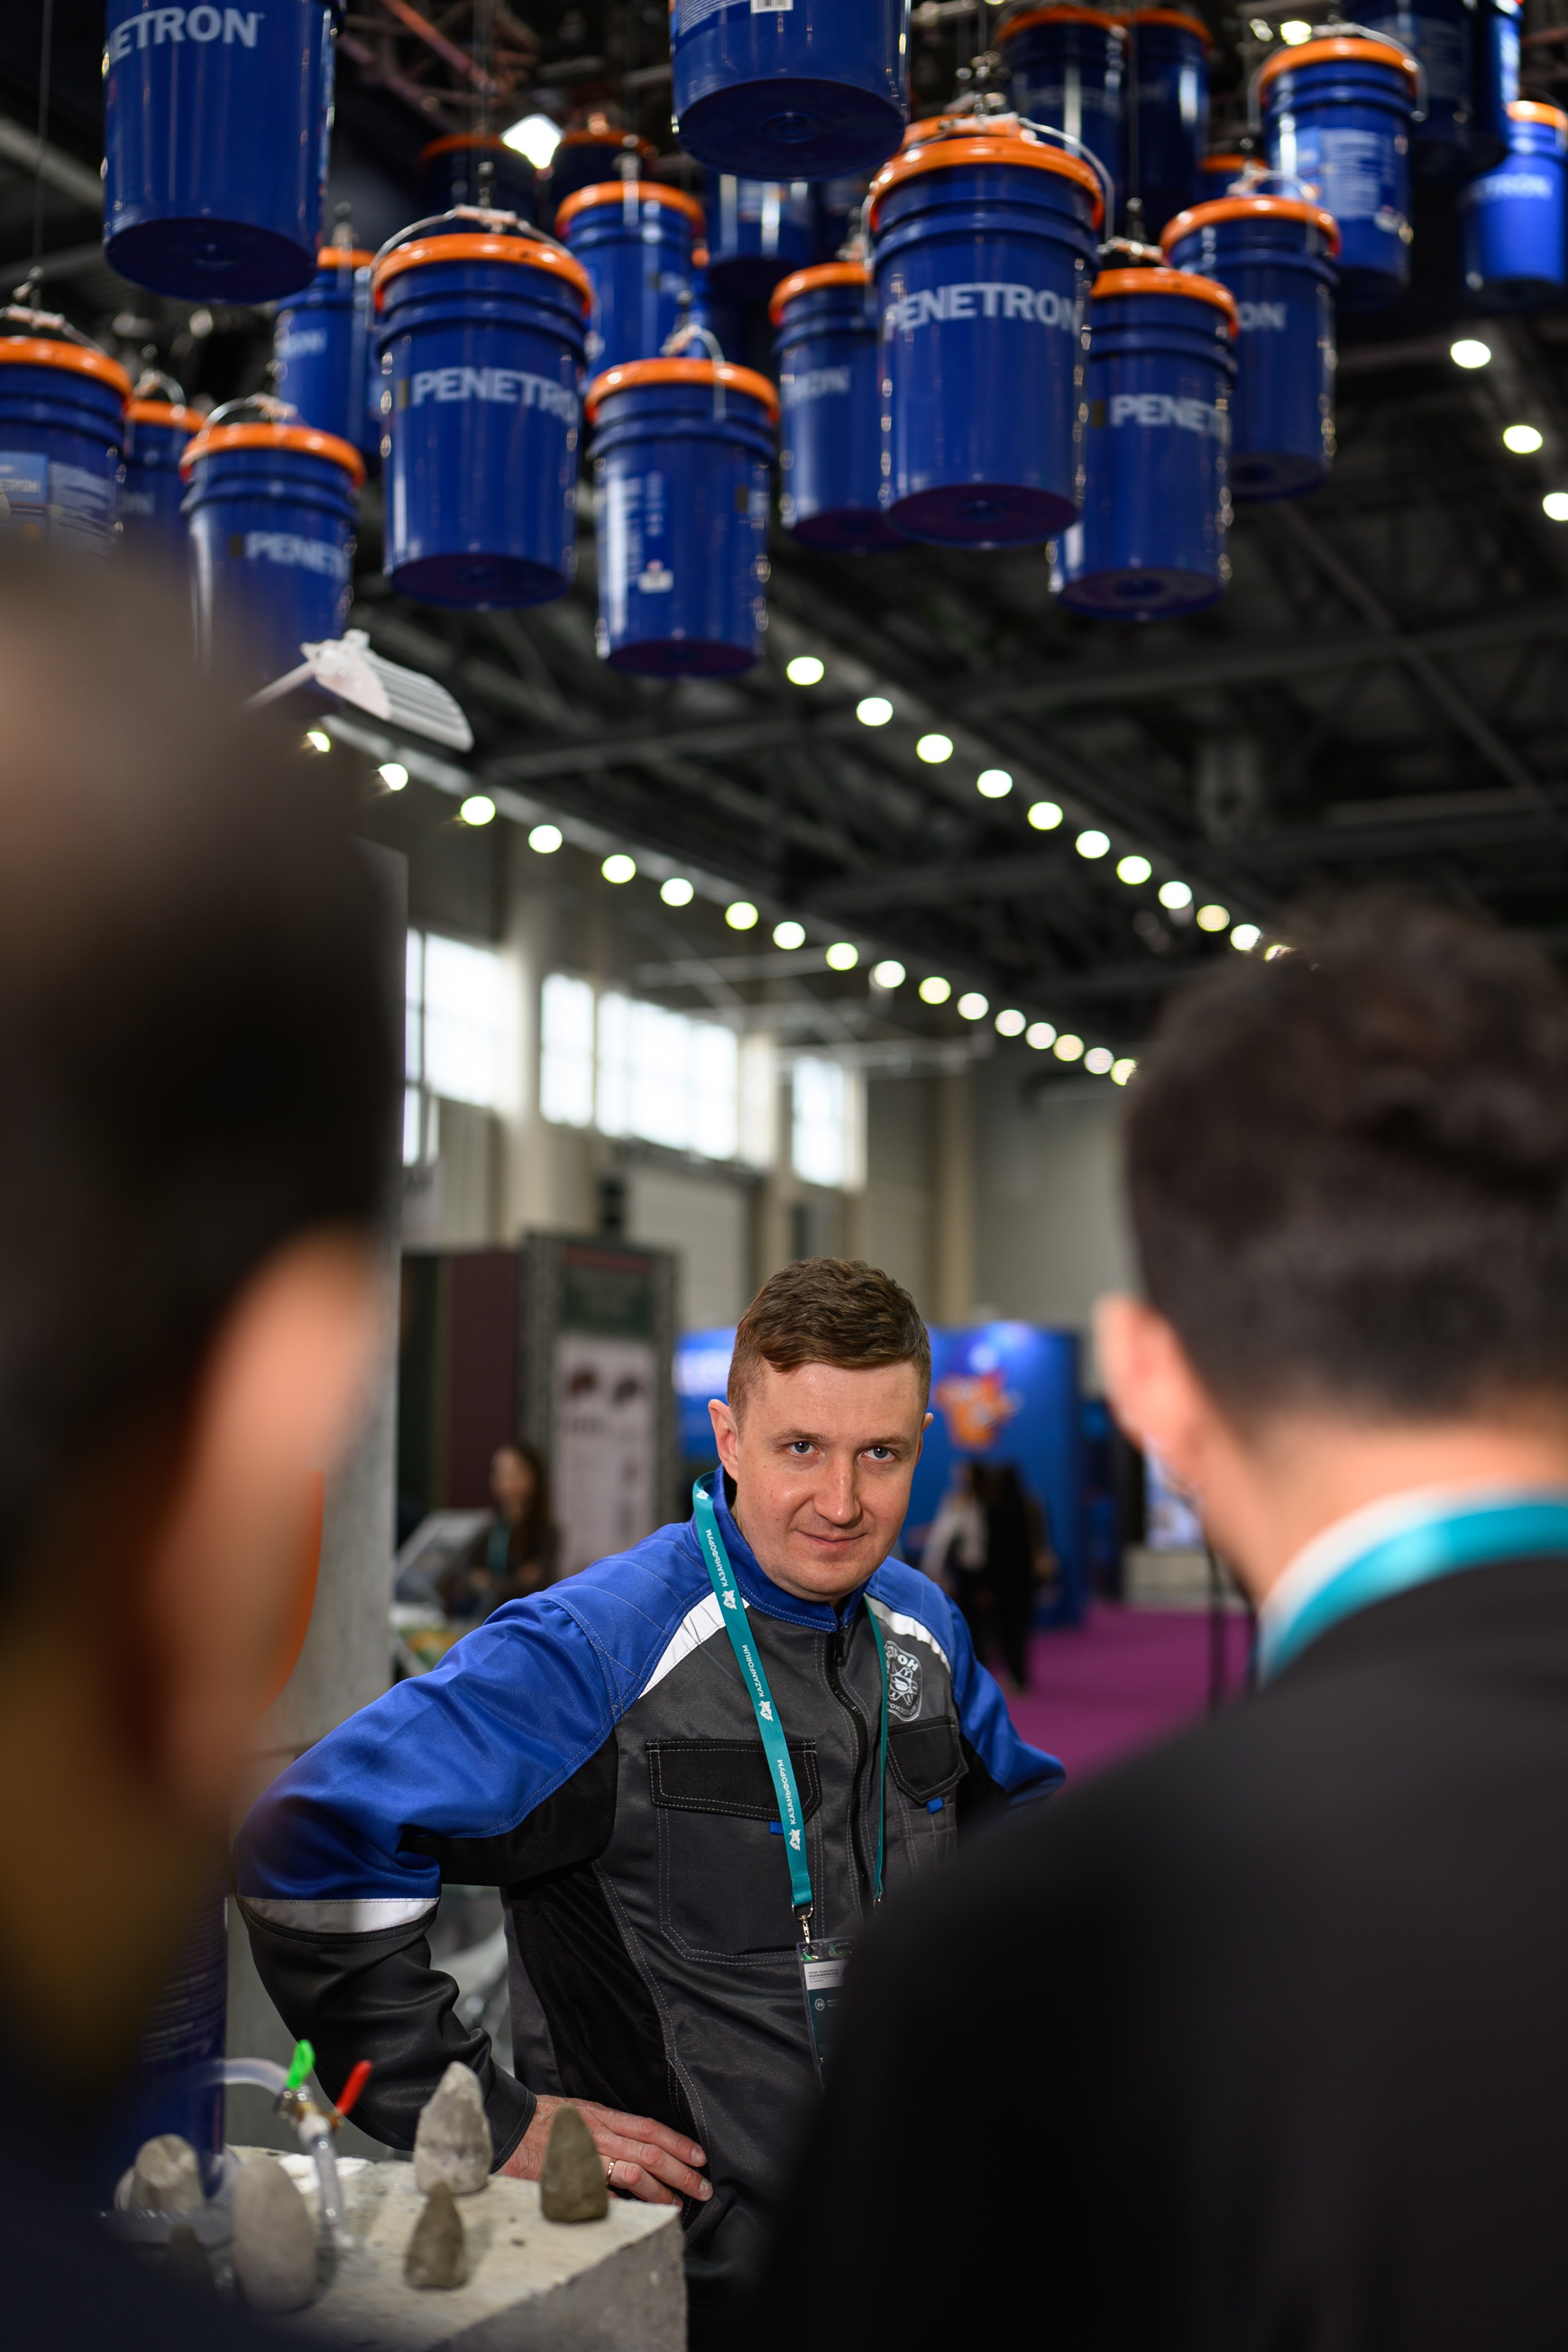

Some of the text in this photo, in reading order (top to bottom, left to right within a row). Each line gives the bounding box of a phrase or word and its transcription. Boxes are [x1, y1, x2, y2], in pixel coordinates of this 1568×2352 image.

[109, 6, 258, 65] ETRON
[706, 1529, 728, 1587] КАЗАНЬФОРУМ
[742, 1645, 764, 1697] KAZANFORUM
[777, 1759, 796, 1825] КАЗАНЬФОРУМ
